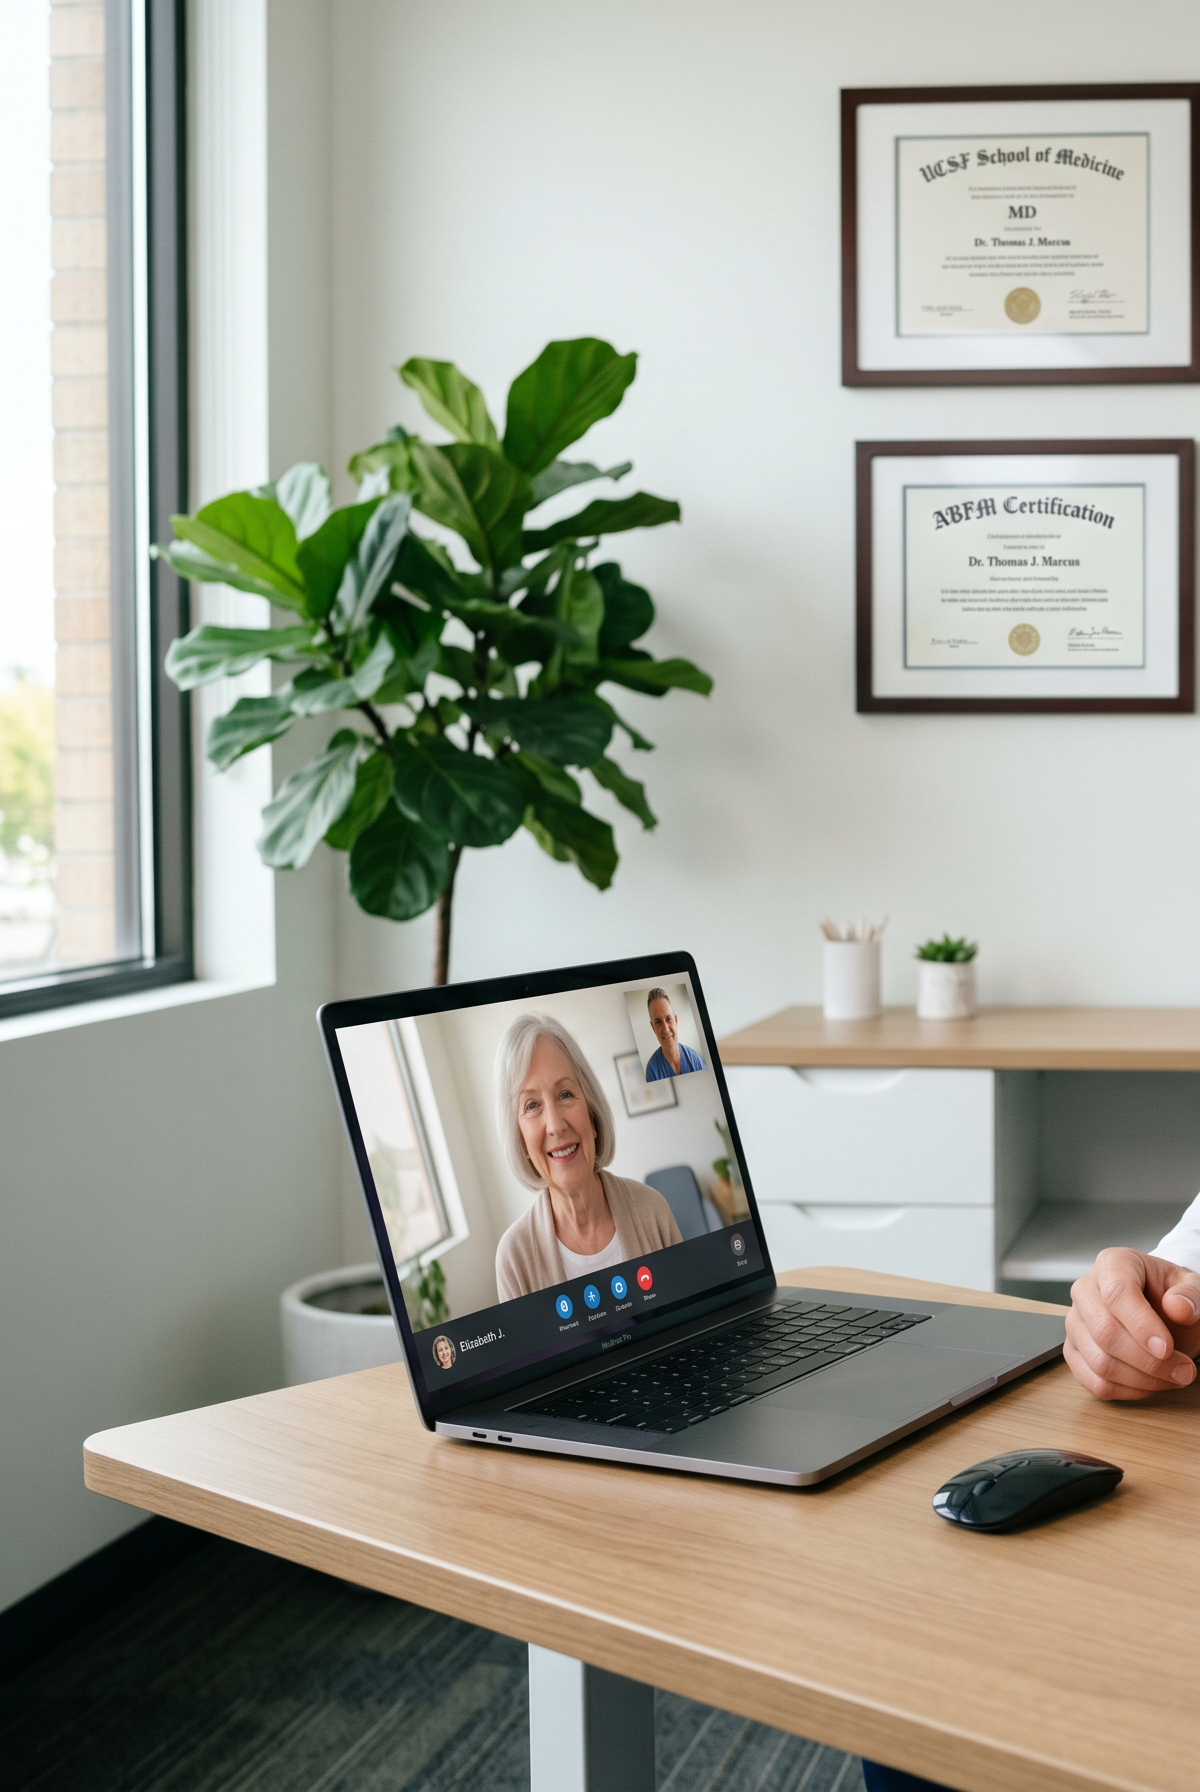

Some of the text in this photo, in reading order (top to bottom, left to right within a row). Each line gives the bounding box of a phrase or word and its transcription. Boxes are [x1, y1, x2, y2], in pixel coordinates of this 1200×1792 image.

[919, 146, 1126, 183] UCSF School of Medicine
[1008, 205, 1037, 219] MD
[932, 496, 1116, 531] ABFM Certification
[968, 556, 1080, 568] Dr. Thomas J. Marcus
[498, 1327, 506, 1339] J.
